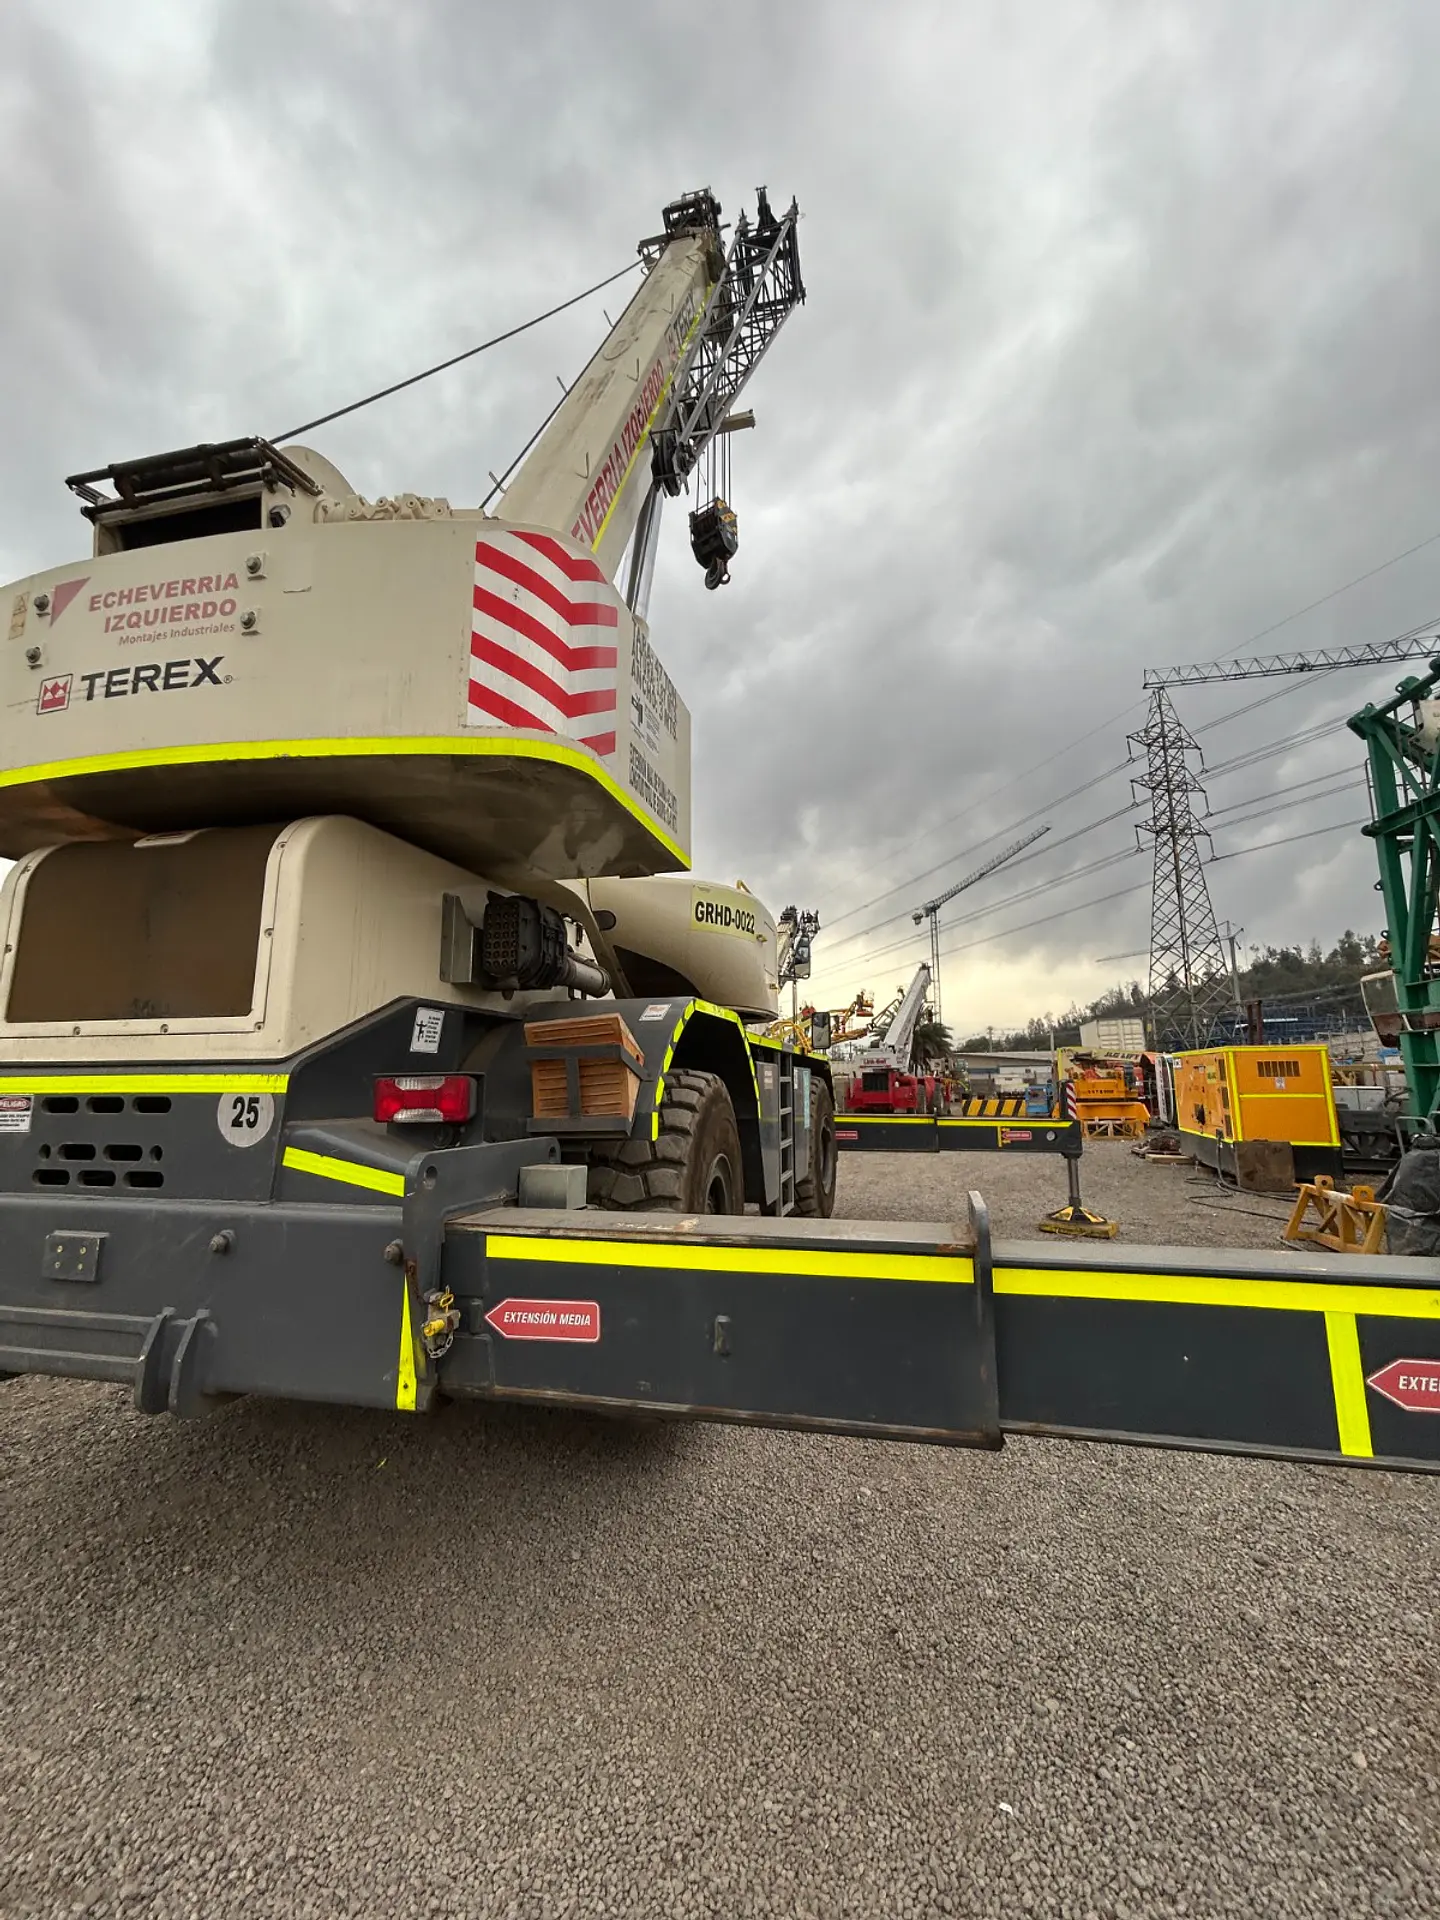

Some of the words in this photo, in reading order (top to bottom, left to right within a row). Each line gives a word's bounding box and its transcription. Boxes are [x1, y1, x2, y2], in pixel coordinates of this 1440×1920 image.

[88, 572, 240, 612] ECHEVERRIA
[103, 598, 237, 634] IZQUIERDO
[118, 632, 168, 647] Montajes
[170, 622, 235, 640] Industriales
[695, 901, 755, 935] GRHD-0022
[231, 1096, 260, 1128] 25
[504, 1310, 557, 1325] EXTENSIÓN
[559, 1314, 591, 1326] MEDIA
